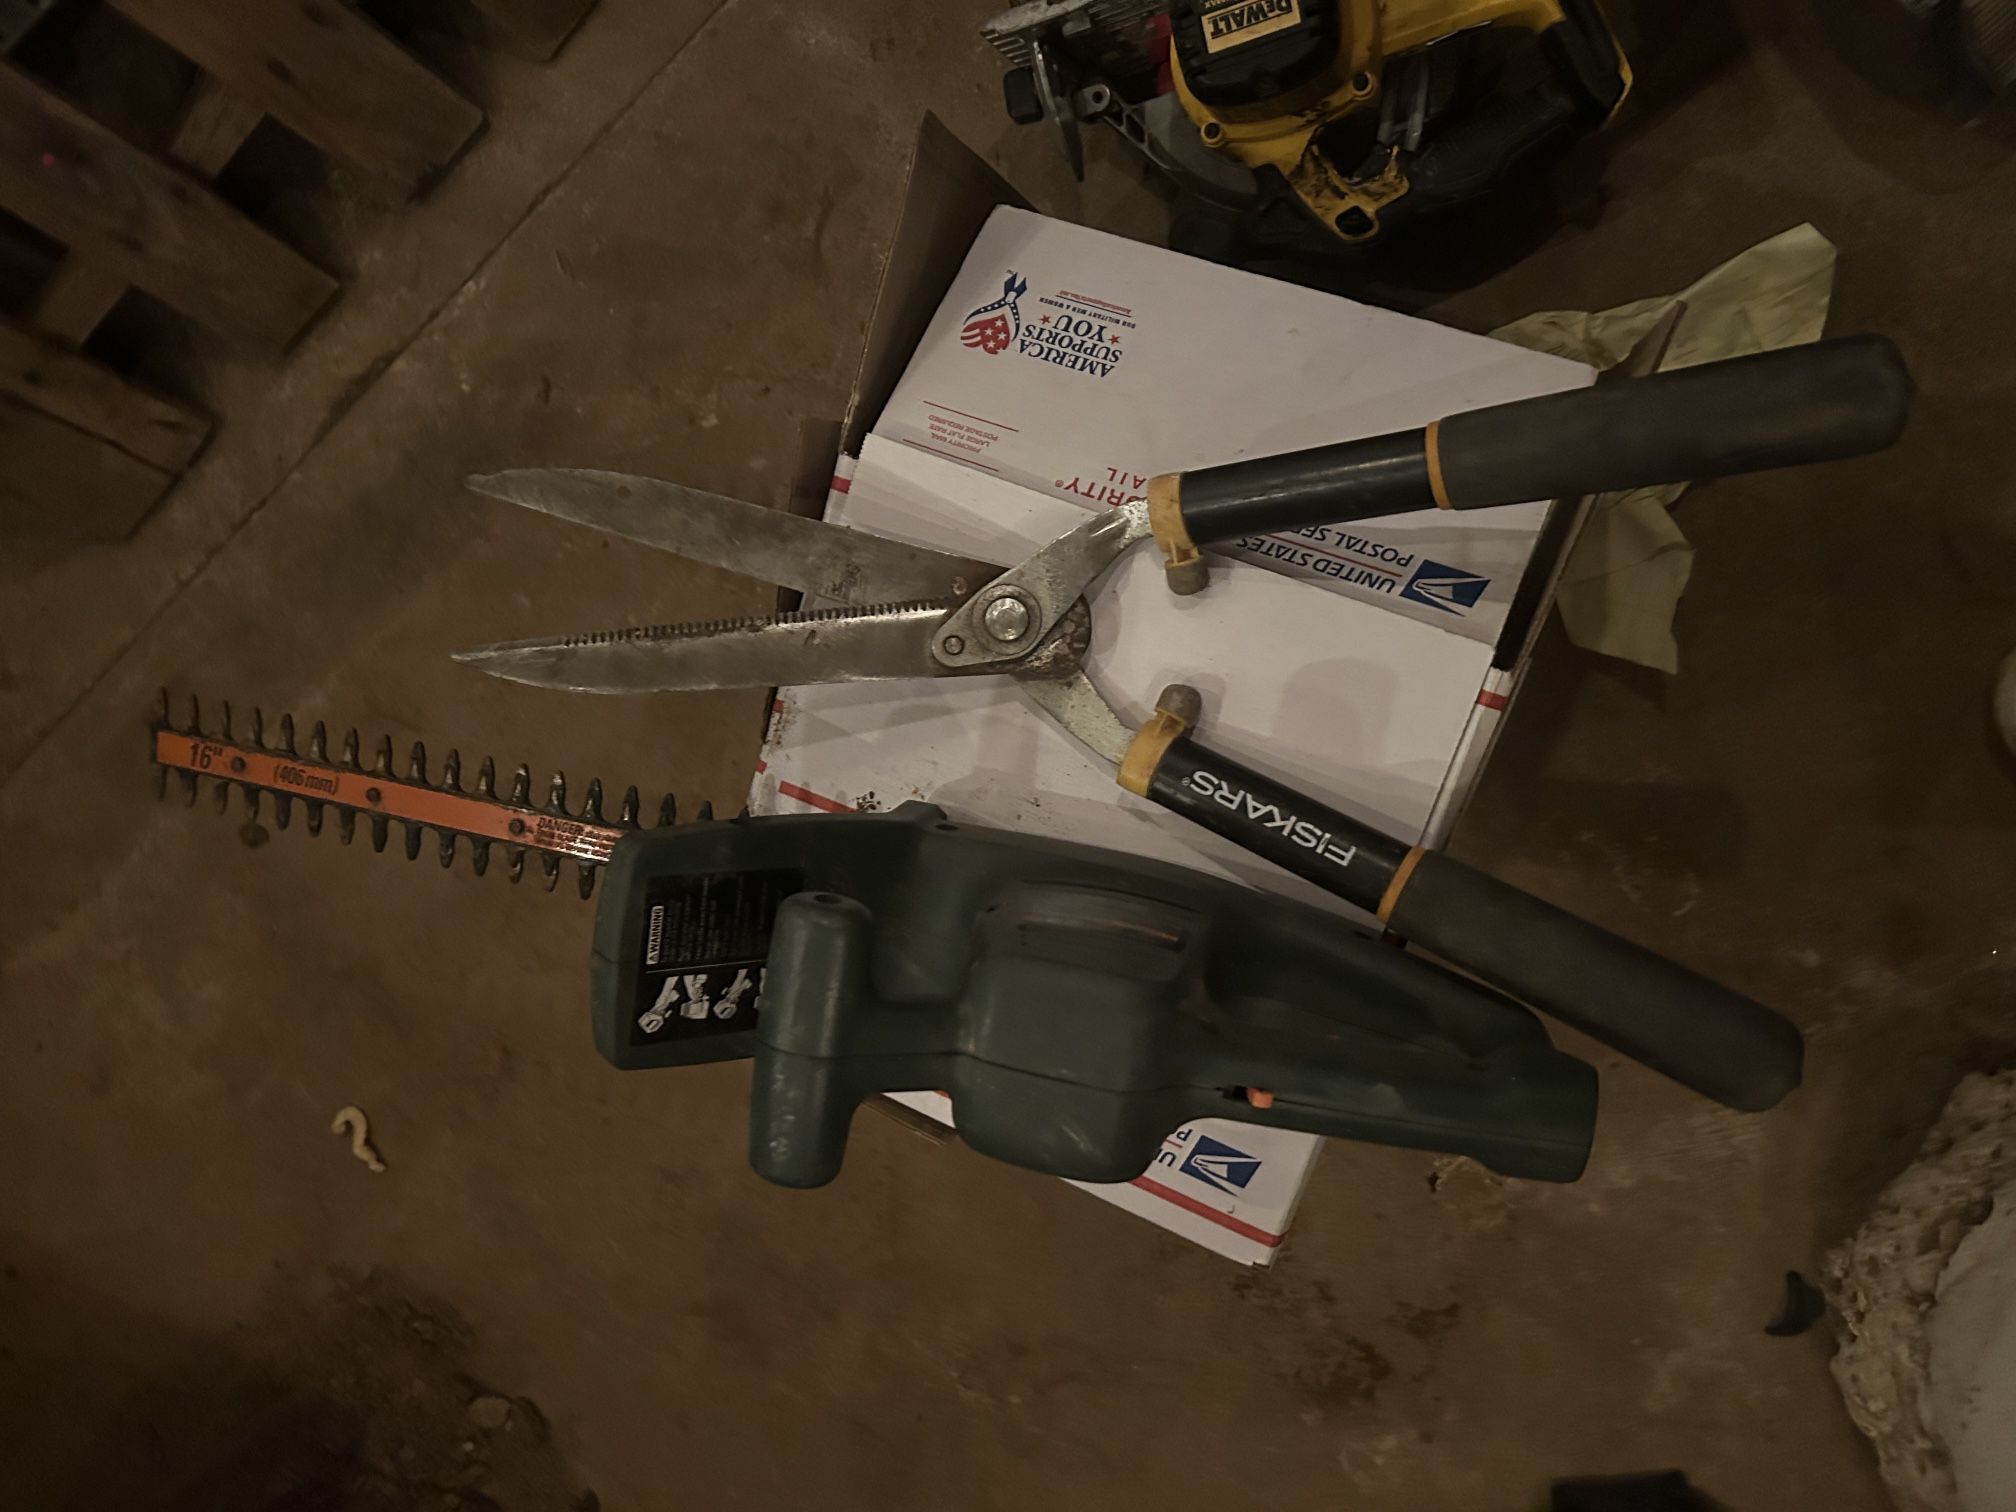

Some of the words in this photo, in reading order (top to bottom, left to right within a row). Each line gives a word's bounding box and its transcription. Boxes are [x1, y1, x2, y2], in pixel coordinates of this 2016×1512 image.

[1039, 297, 1064, 309] WOMEN
[1071, 306, 1088, 316] MEN
[1088, 311, 1121, 325] MILITARY
[1052, 314, 1107, 343] YOU
[1022, 324, 1123, 363] SUPPORTS
[1018, 339, 1115, 378] AMERICA
[927, 414, 965, 431] REQUIRED
[928, 423, 947, 434] RATE
[930, 432, 947, 444] MAIL
[947, 430, 965, 440] FLAT
[965, 425, 999, 441] POSTAGE
[965, 435, 990, 448] LARGE
[947, 438, 982, 454] PRIORITY
[1105, 466, 1147, 489] AIL
[1235, 535, 1313, 566] STATES
[1334, 531, 1415, 568] POSTAL
[1311, 558, 1396, 594] UNITED
[536, 816, 584, 836] DANGER
[649, 907, 662, 954] WARNING
